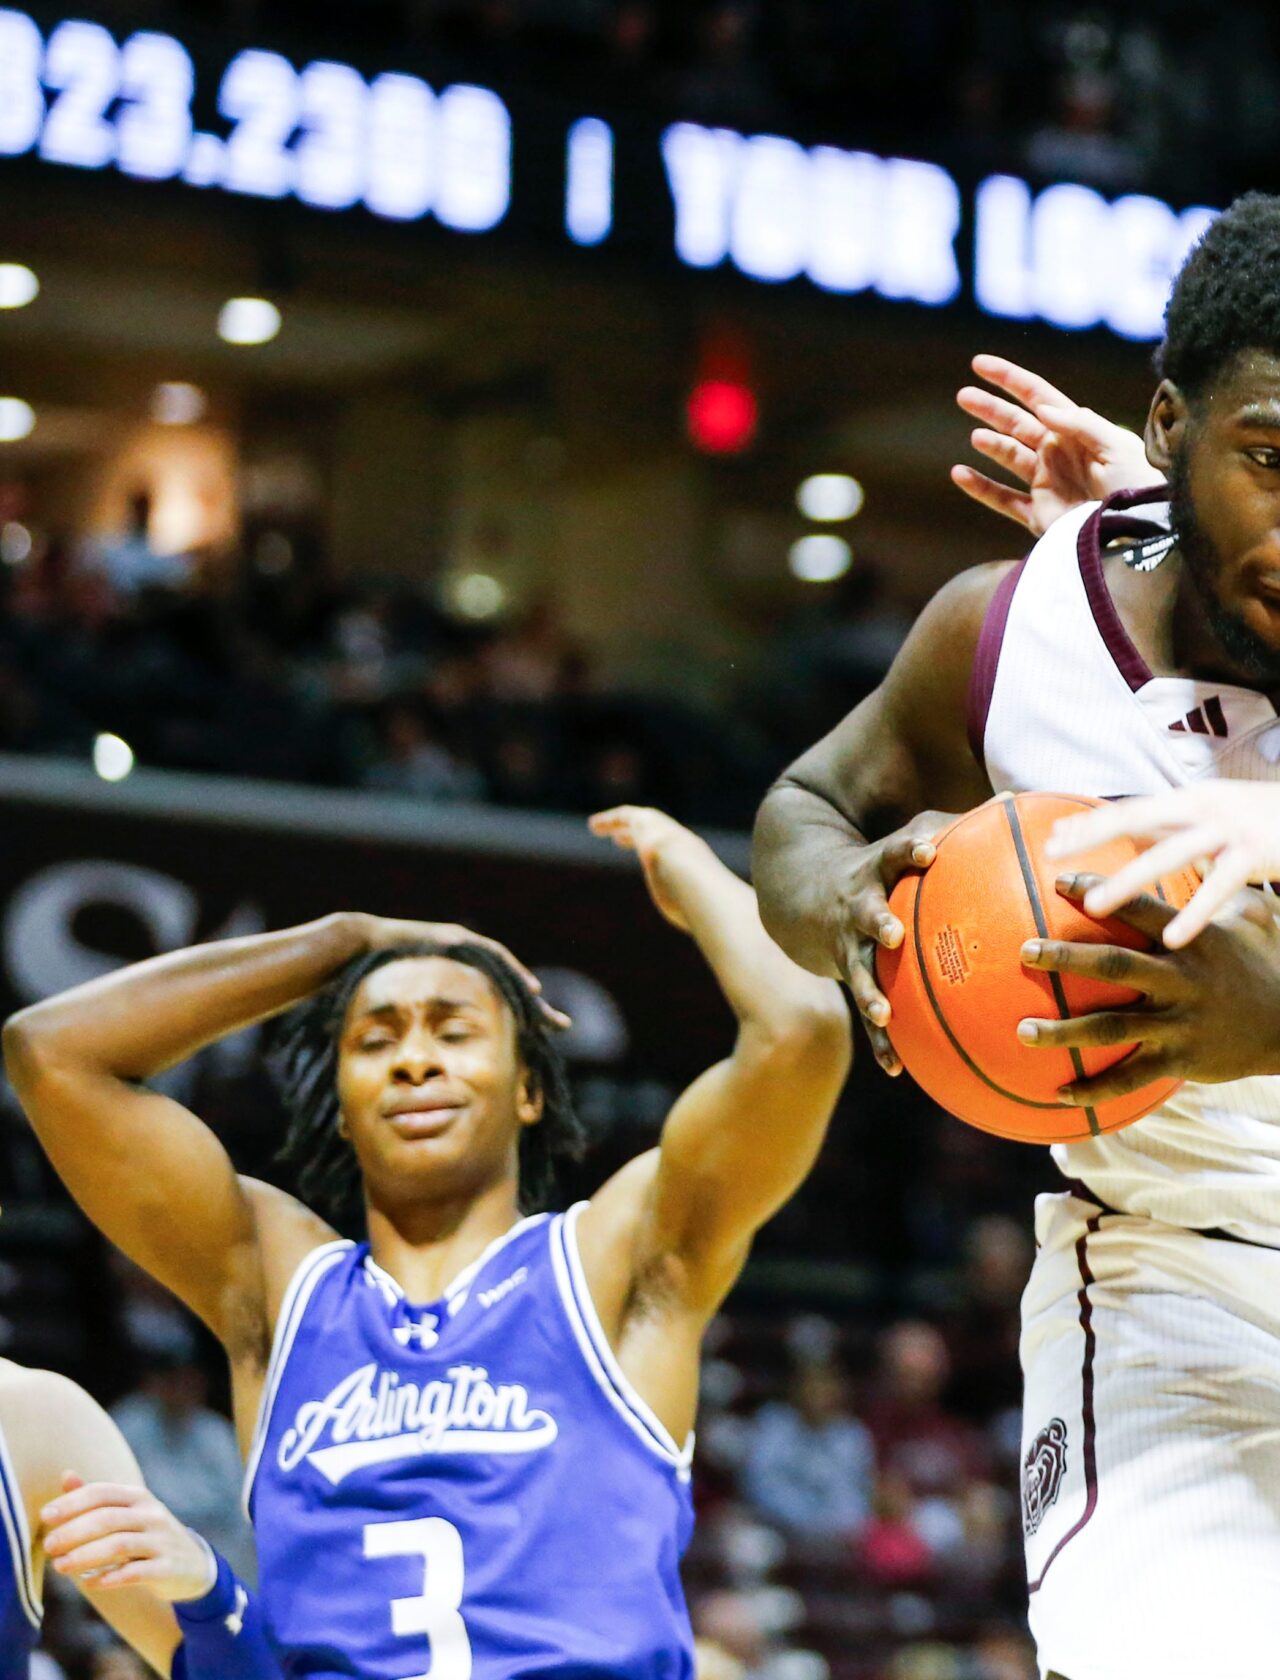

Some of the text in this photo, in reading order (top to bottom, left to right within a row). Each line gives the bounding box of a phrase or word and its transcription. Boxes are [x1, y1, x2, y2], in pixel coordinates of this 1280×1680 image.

[665, 122, 957, 303] YOUR
[977, 175, 1221, 338] LOC
[277, 1361, 548, 1472] Arlington
[362, 1516, 473, 1680] 3
